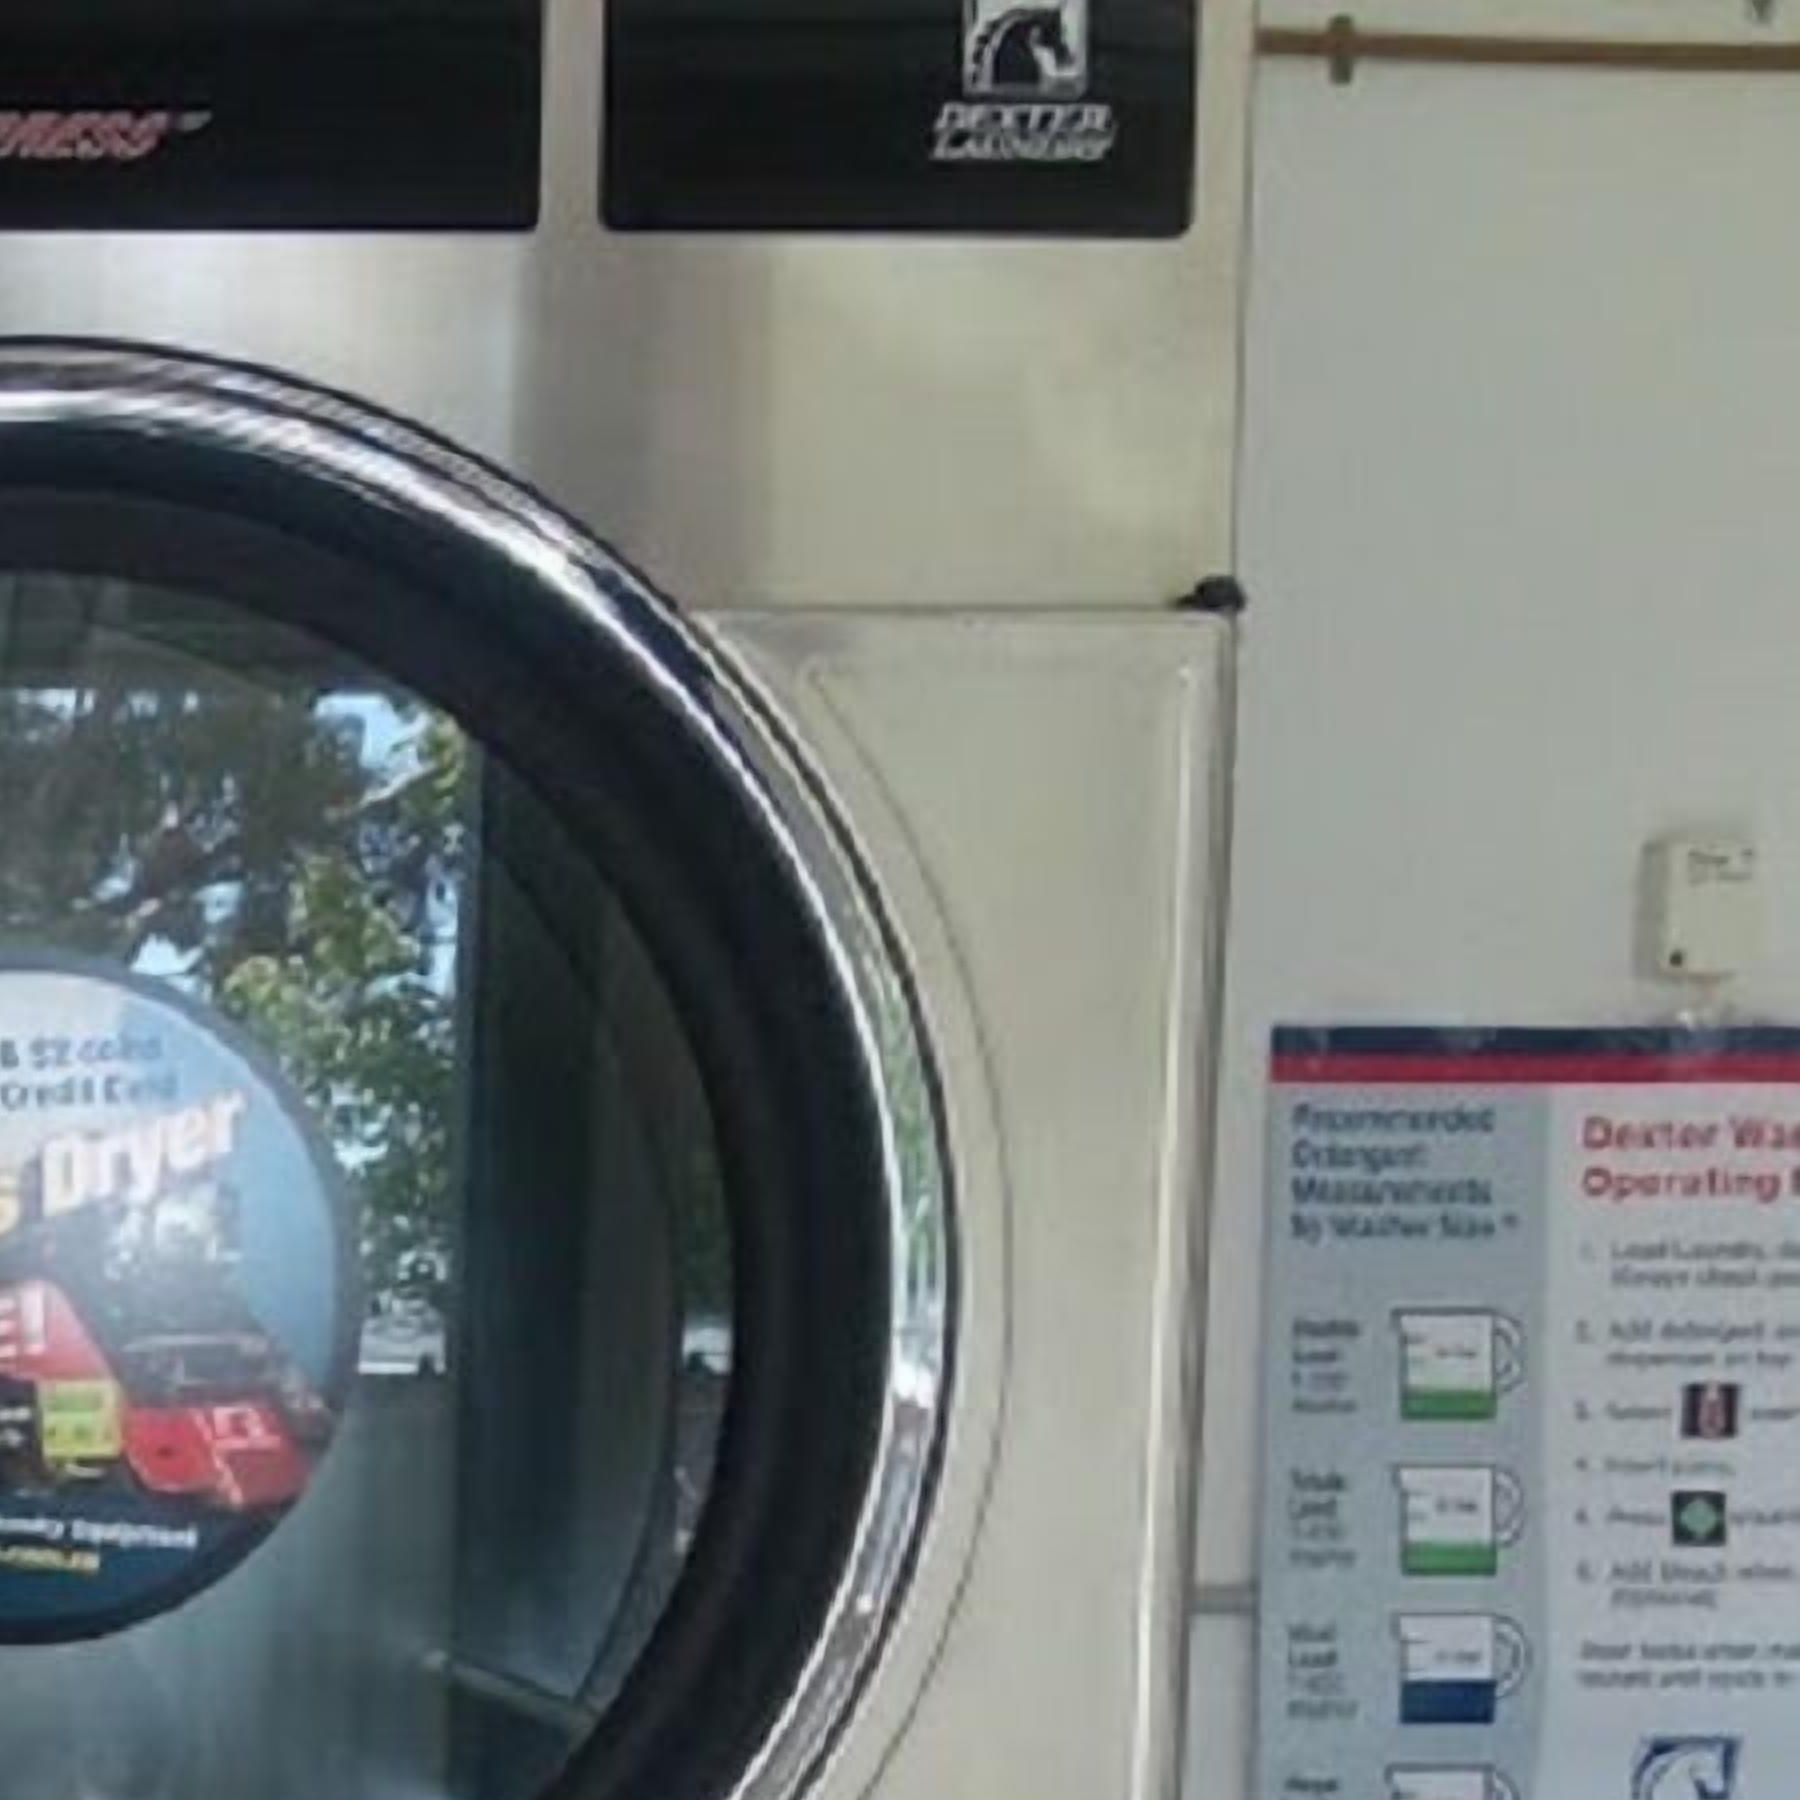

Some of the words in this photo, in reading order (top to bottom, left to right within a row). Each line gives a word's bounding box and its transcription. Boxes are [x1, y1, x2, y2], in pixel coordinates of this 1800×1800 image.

[1583, 1115, 1719, 1149] Dexter
[39, 1088, 249, 1216] Dryer
[1583, 1166, 1781, 1204] Operating
